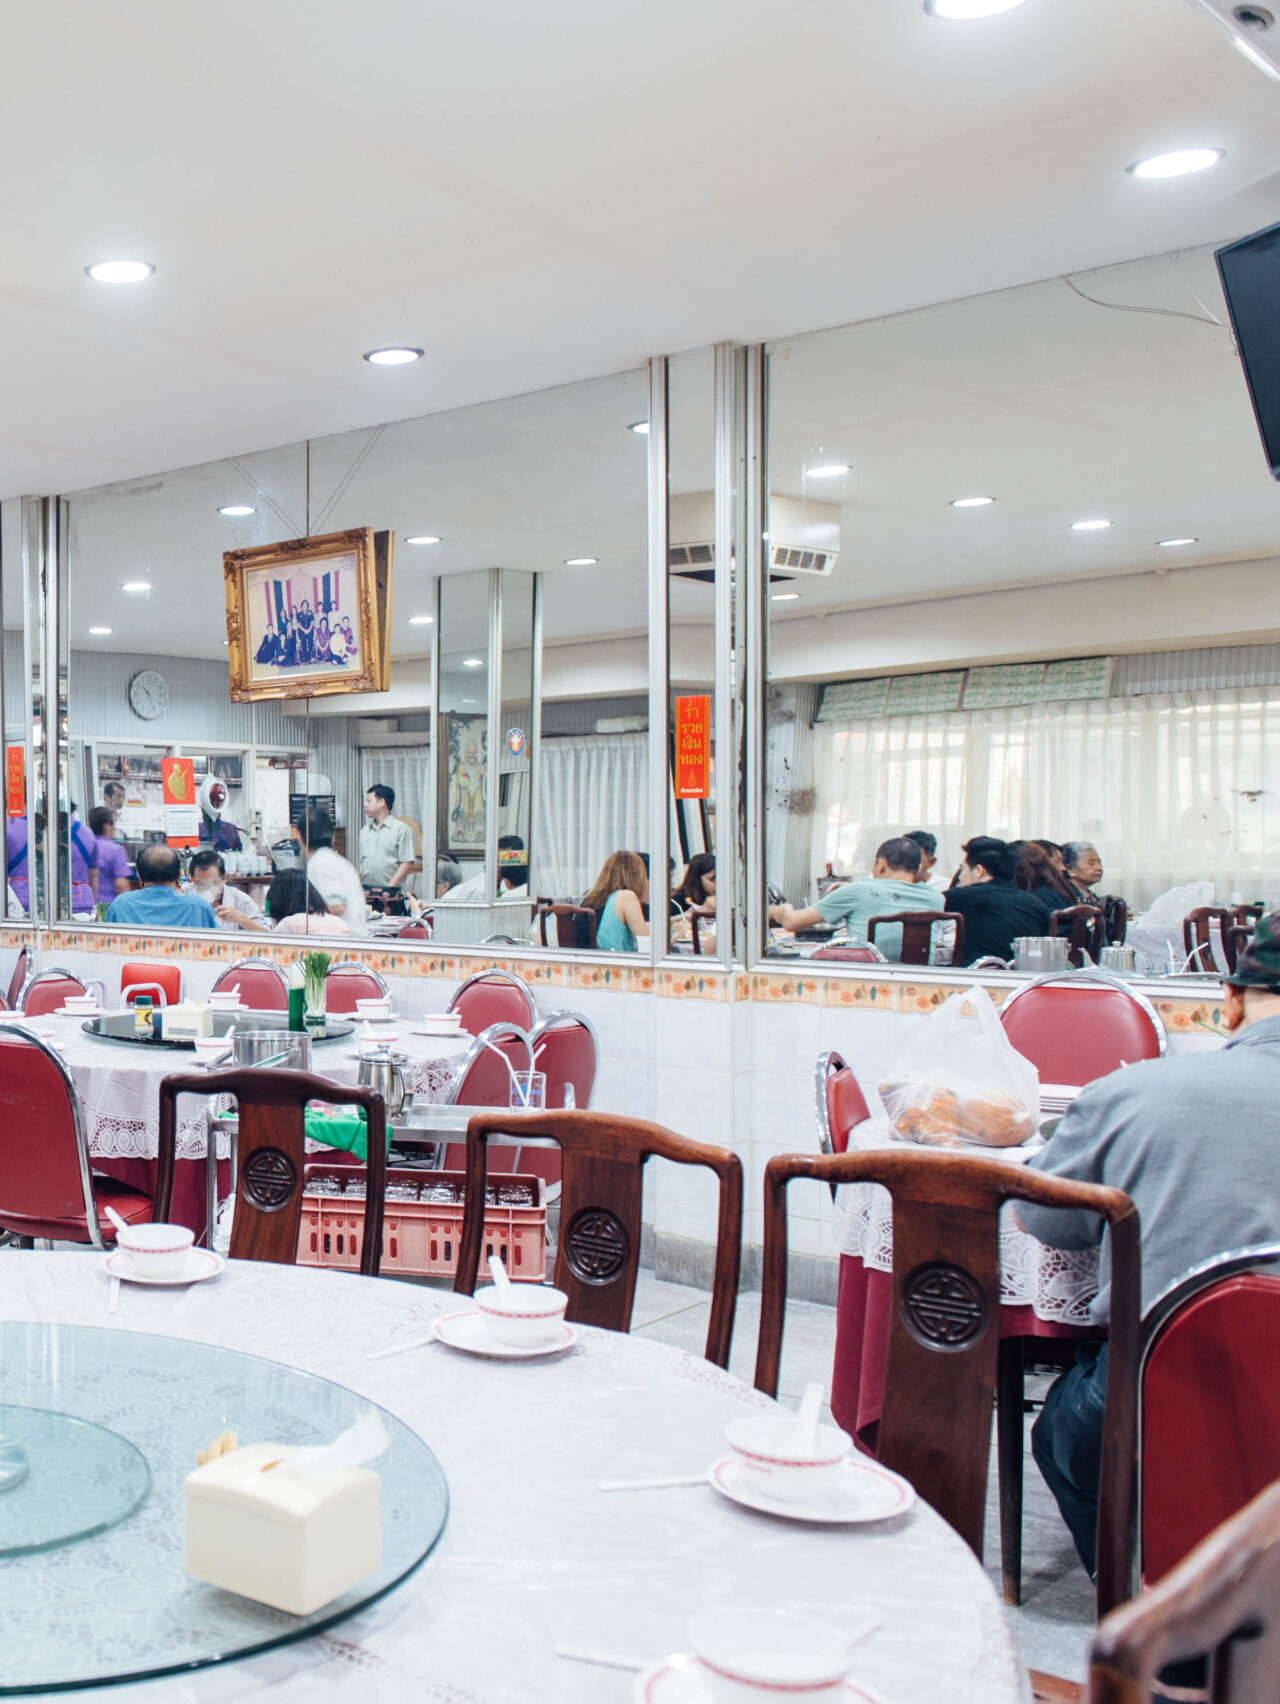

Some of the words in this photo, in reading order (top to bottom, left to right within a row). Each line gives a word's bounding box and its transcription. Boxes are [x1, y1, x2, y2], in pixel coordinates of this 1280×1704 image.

[681, 723, 703, 734] รวย
[683, 735, 702, 749] เงิน
[681, 755, 703, 765] ทอง
